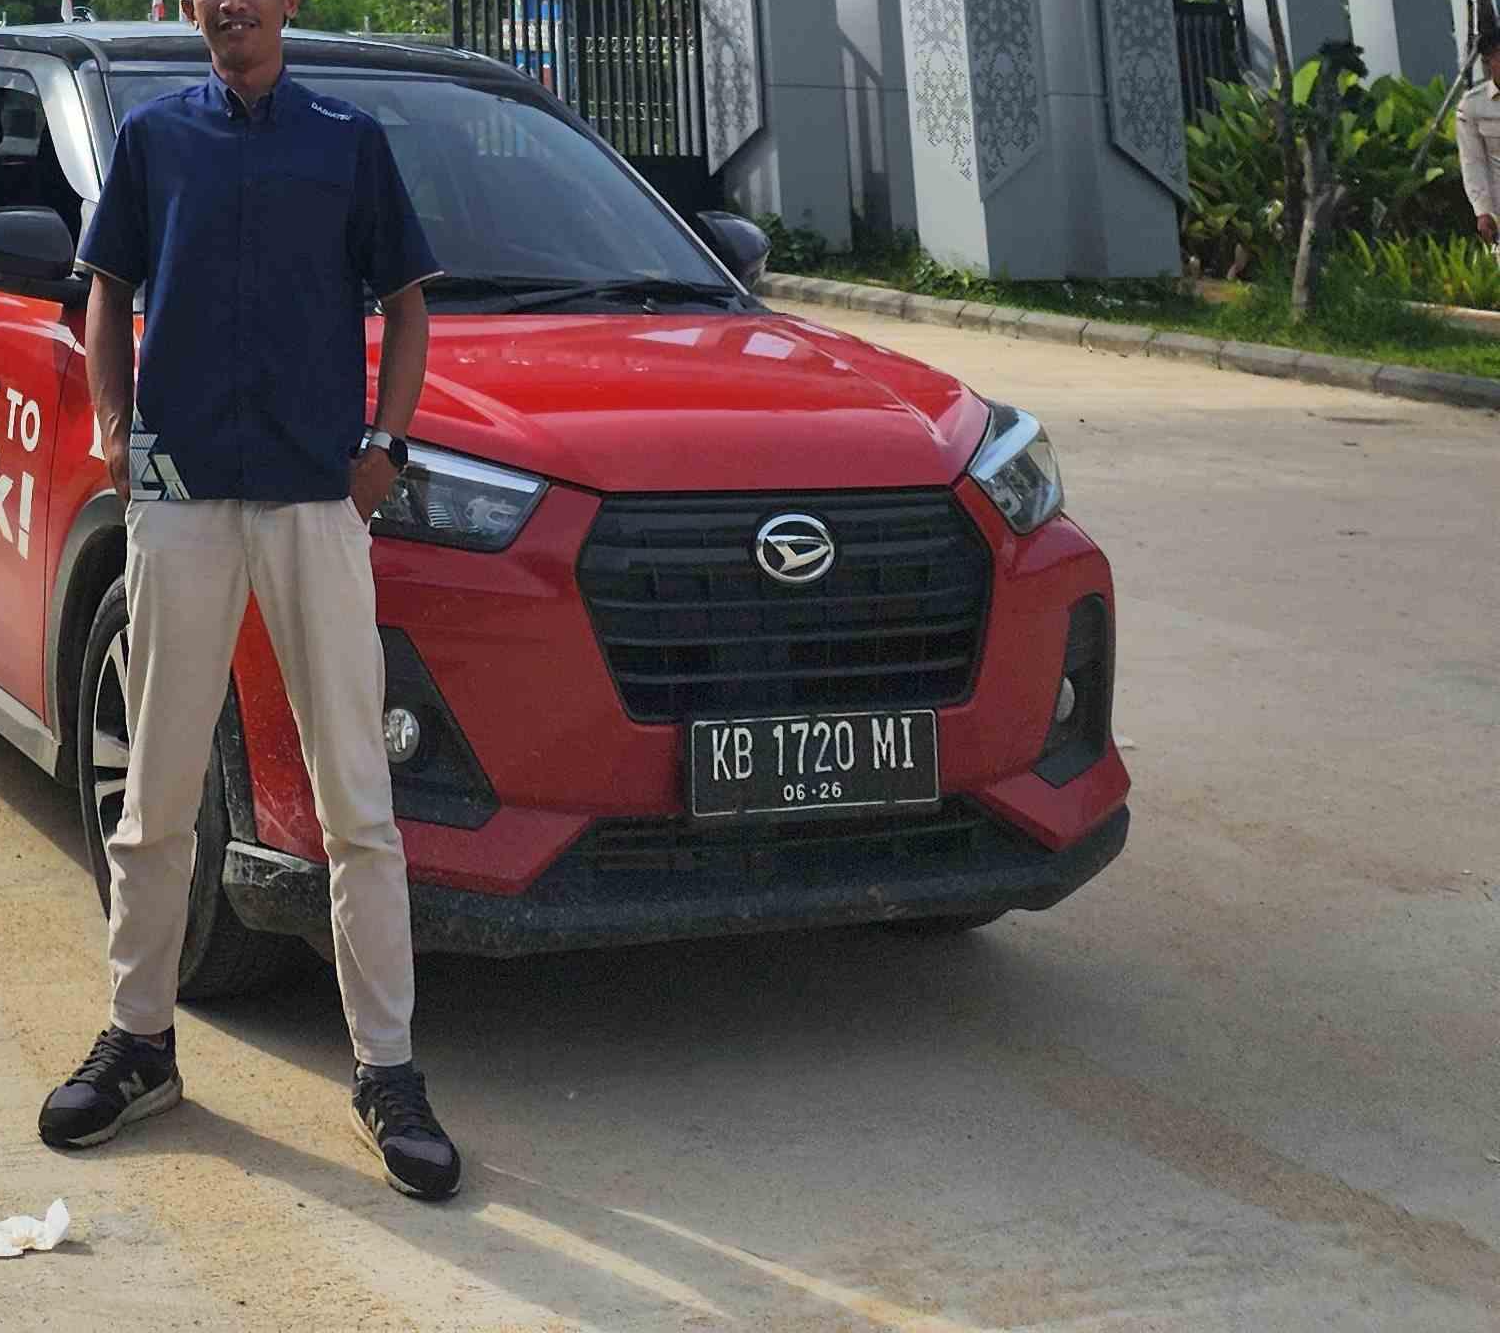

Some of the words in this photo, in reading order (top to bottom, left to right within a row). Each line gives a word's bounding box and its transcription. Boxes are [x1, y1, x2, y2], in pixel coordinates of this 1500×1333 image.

[6, 387, 41, 453] TO
[711, 727, 753, 781] KB
[772, 720, 855, 776] 1720
[871, 716, 915, 770] MI
